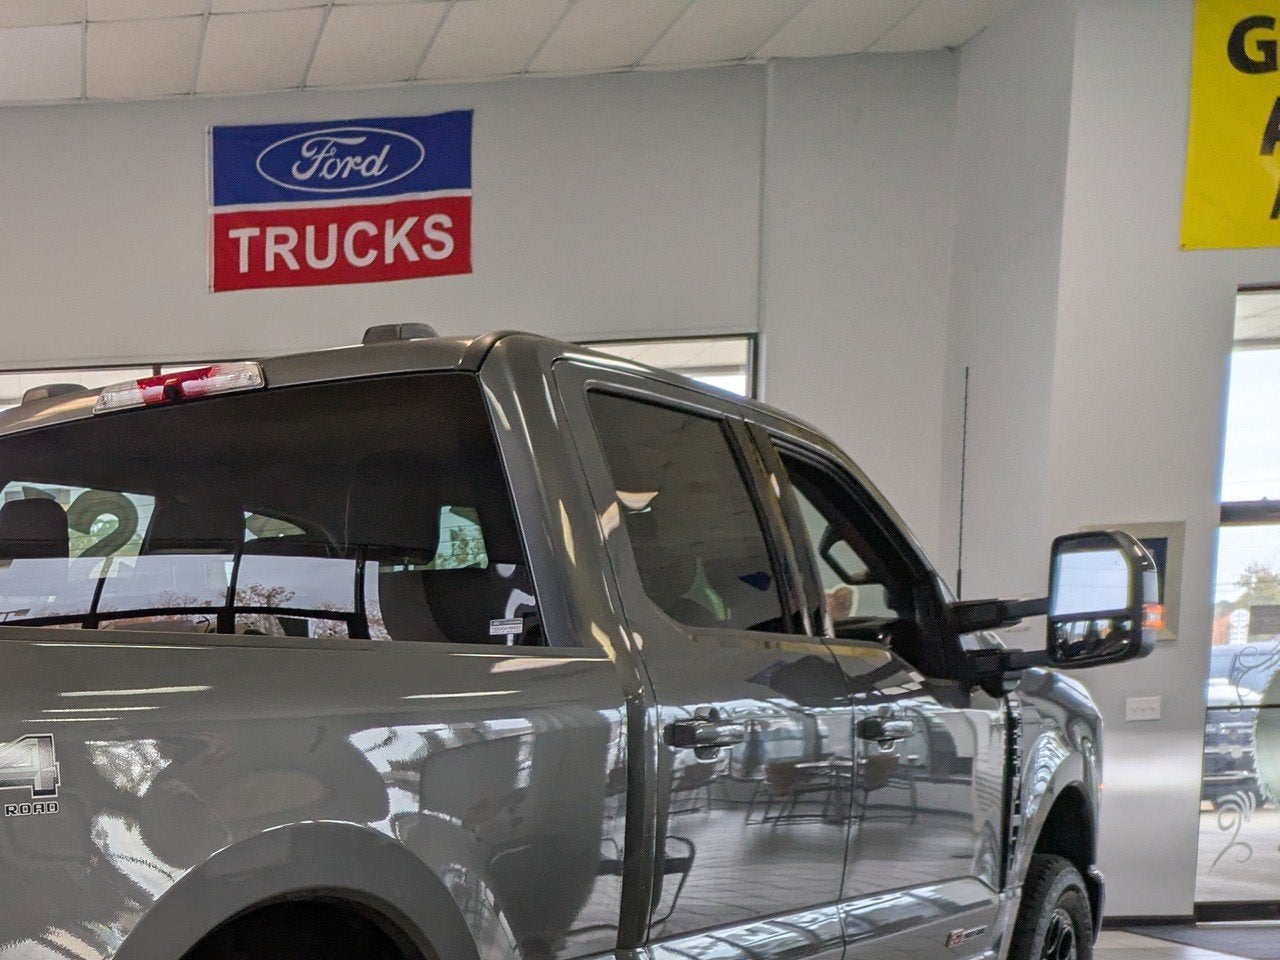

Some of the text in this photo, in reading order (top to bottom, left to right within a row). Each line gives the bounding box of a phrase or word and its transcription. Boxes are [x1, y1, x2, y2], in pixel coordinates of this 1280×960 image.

[291, 136, 391, 181] Ford
[228, 213, 455, 274] TRUCKS
[5, 801, 59, 817] ROAD
